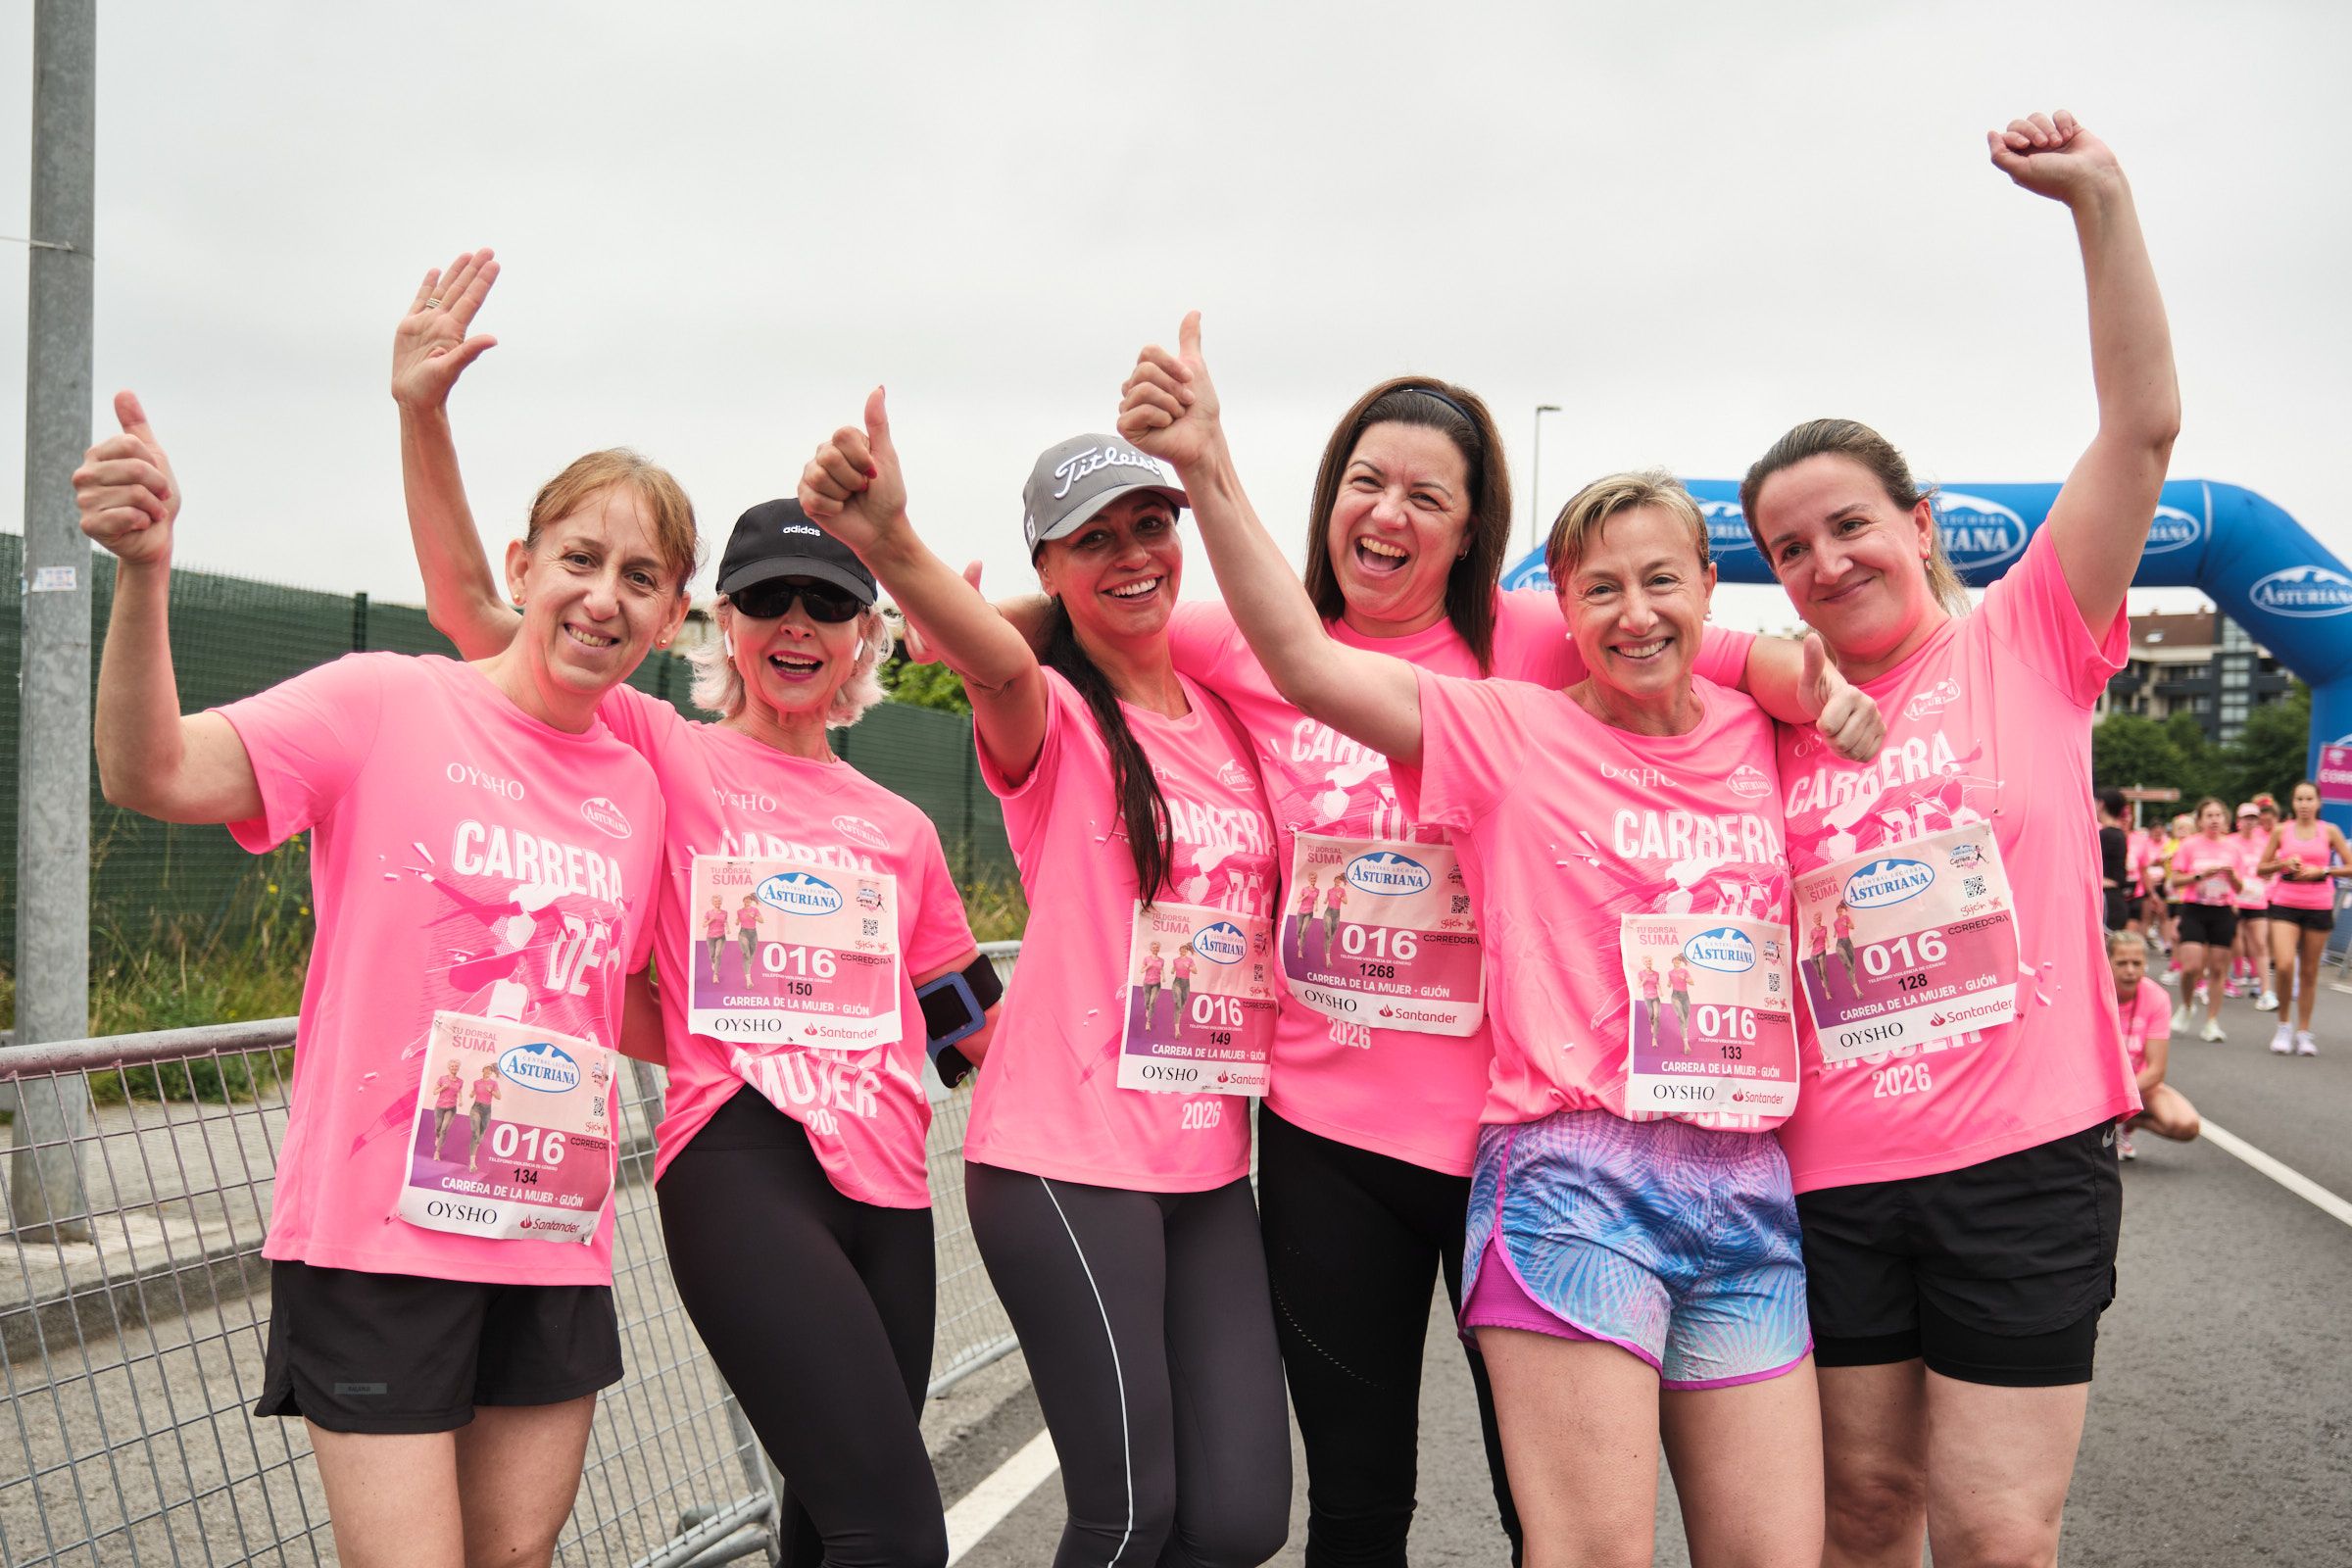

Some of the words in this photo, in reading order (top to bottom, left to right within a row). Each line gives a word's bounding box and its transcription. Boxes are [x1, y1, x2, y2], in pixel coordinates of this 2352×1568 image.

[1054, 447, 1160, 500] Titleist
[783, 525, 821, 536] adidas
[2258, 584, 2352, 605] ASTURIAN
[1794, 735, 1822, 757] OYS
[447, 763, 524, 800] OYSHO
[713, 787, 776, 812] YSHO
[1613, 808, 1784, 865] CARRERA
[453, 819, 624, 911] CARRERA
[1308, 854, 1343, 865] SUMA
[712, 875, 753, 886] SUMA
[1352, 864, 1424, 887] ASTURIANA
[764, 884, 836, 907] ASTURIANA
[1810, 883, 1840, 903] SUMA
[1849, 872, 1929, 903] ASTURIANA
[1152, 921, 1191, 934] SUMA
[1948, 915, 2008, 935] CORREDORA
[1200, 935, 1244, 956] ASTURIANA
[1342, 925, 1417, 959] 016
[1640, 935, 1679, 946] SUMA
[762, 943, 837, 977] 016
[1692, 943, 1752, 963] ASTURIANA
[1863, 930, 1948, 976] 016
[1360, 963, 1395, 978] 1268
[788, 982, 811, 996] 150
[1307, 972, 1347, 987] CARRERA
[1349, 978, 1360, 989] DE
[1363, 981, 1375, 991] LA
[1378, 982, 1411, 995] MUJER
[1421, 985, 1449, 998] GIJÓN
[1898, 973, 1928, 991] 128
[723, 997, 770, 1006] CARRERA
[773, 998, 785, 1007] DE
[788, 999, 799, 1008] LA
[803, 1000, 834, 1012] MUJER
[843, 1004, 869, 1015] GIJÓN
[1305, 990, 1357, 1012] OYSHO
[1396, 1008, 1457, 1024] Santander
[1839, 1003, 1886, 1021] CARRERA
[1886, 999, 1901, 1010] DE
[1903, 996, 1918, 1006] LA
[1920, 985, 1957, 1002] MUJER
[1966, 973, 1997, 991] GIJÓN
[1192, 995, 1243, 1026] 016
[715, 1018, 781, 1032] OYSHO
[820, 1026, 878, 1040] Santander
[1327, 1018, 1371, 1049] 2026
[1697, 1005, 1757, 1040] 016
[1839, 1021, 1904, 1048] OYSHO
[1947, 999, 2013, 1023] Santander
[453, 1036, 497, 1054] SUMA
[465, 1029, 498, 1041] DORSAL
[1210, 1032, 1231, 1045] 149
[1152, 1045, 1192, 1057] CARRERA
[1195, 1049, 1205, 1057] DE
[1207, 1050, 1217, 1058] LA
[1220, 1051, 1246, 1060] MUJER
[1722, 1046, 1741, 1059] 133
[506, 1055, 575, 1084] ASTURIANA
[1143, 1065, 1198, 1082] OYSHO
[1661, 1061, 1705, 1074] CARRERA
[1709, 1063, 1720, 1074] DE
[1722, 1064, 1733, 1074] LA
[1734, 1064, 1757, 1076] MUJER
[1872, 1062, 1933, 1099] 2026
[1653, 1084, 1714, 1101] OYSHO
[1745, 1093, 1784, 1104] Santander
[1181, 1102, 1222, 1130] 2026
[492, 1123, 565, 1164] 016
[514, 1168, 538, 1185] 134
[442, 1176, 490, 1195] CARRERA
[494, 1186, 509, 1197] DE
[510, 1188, 523, 1200] LA
[525, 1190, 554, 1206] MUJER
[427, 1200, 498, 1225] OYSHO
[532, 1218, 580, 1233] Santander
